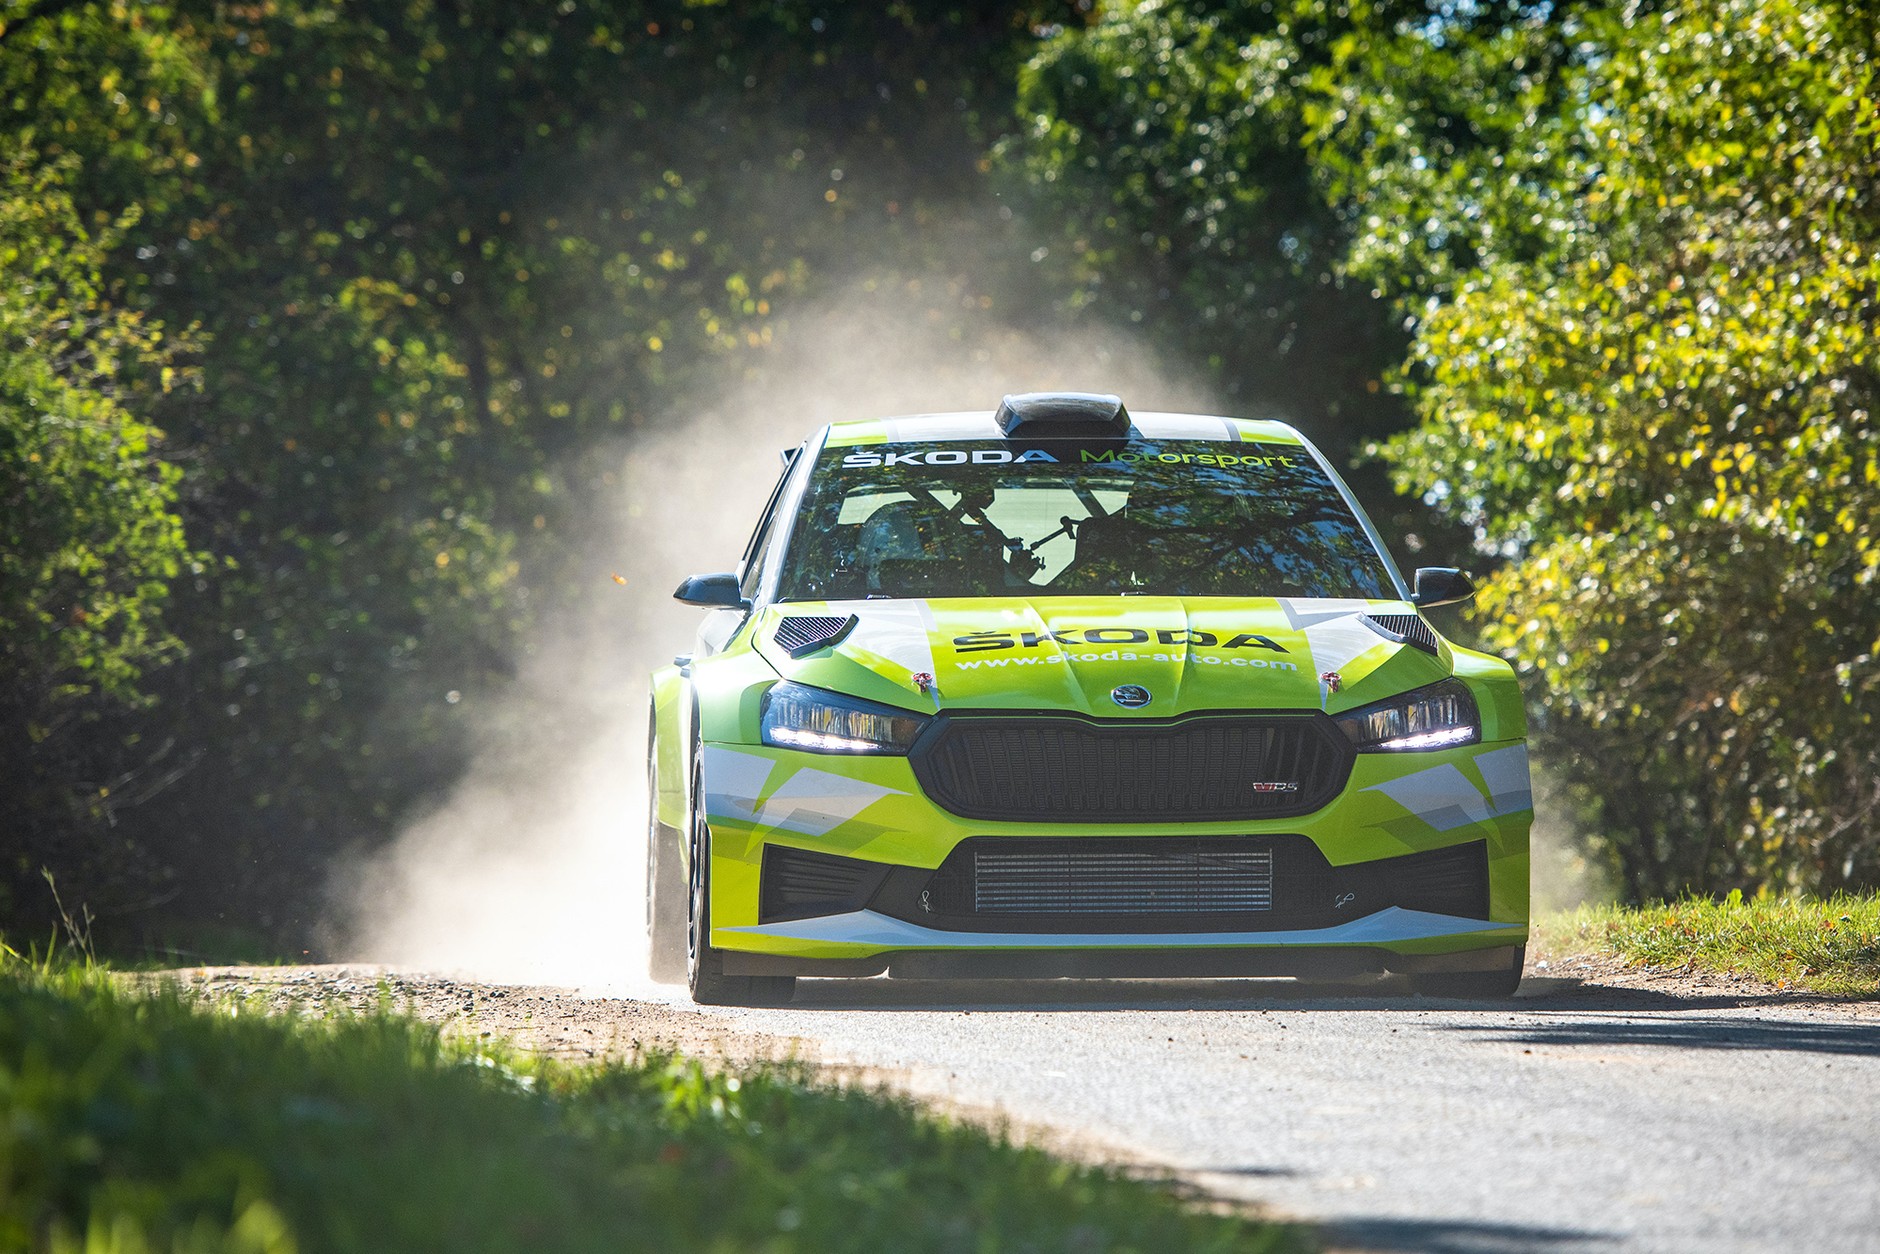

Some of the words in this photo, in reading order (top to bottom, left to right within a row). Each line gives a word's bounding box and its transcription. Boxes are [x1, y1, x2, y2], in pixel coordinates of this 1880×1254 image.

[841, 449, 1060, 469] ŠKODA
[1080, 449, 1298, 468] Motorsport
[952, 628, 1291, 654] ŠKODA
[955, 650, 1298, 672] www.skoda-auto.com
